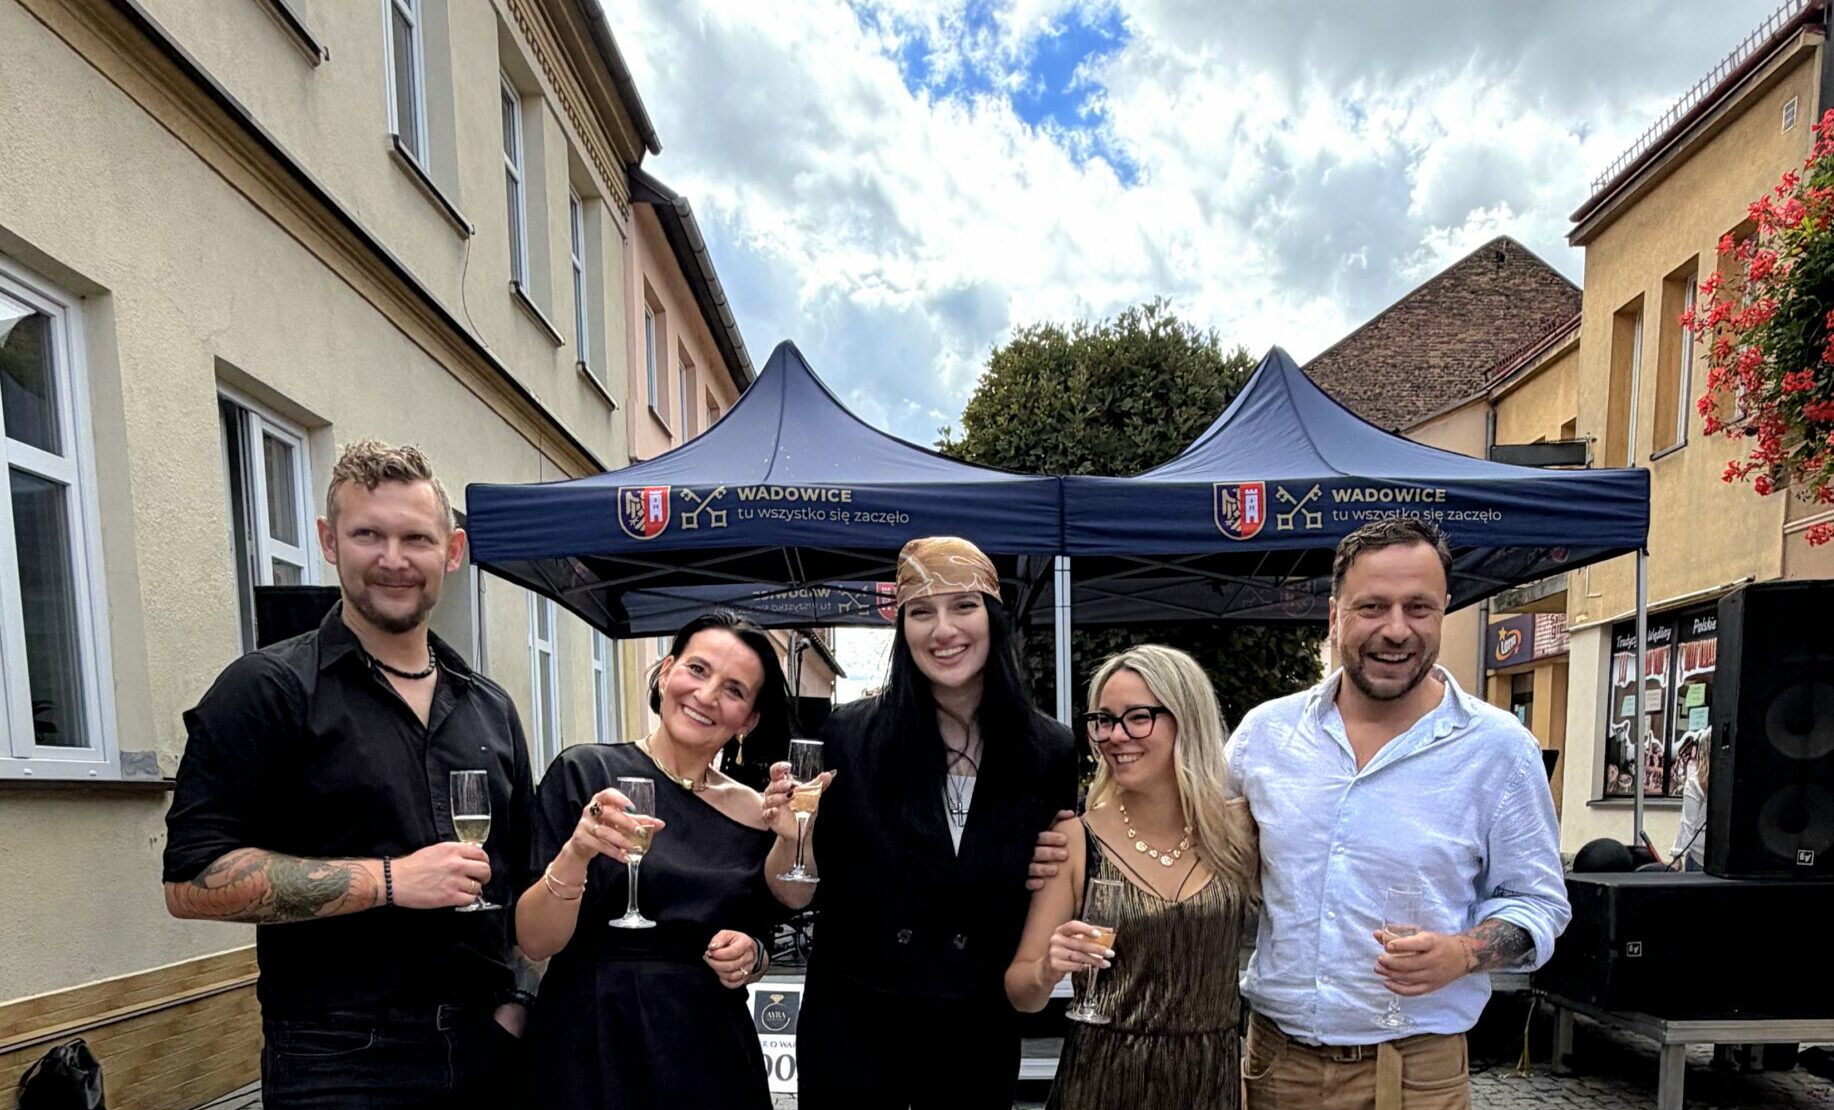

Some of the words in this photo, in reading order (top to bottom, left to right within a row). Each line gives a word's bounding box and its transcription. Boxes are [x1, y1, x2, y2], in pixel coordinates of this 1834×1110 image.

[737, 486, 852, 503] WADOWICE
[1332, 488, 1447, 503] WADOWICE
[738, 508, 753, 519] tu
[758, 507, 826, 522] wszystko
[829, 508, 850, 525] się
[854, 510, 910, 526] zaczęło
[1333, 509, 1348, 521] tu
[1352, 507, 1420, 521] wszystko
[1423, 508, 1444, 524] się
[1447, 508, 1502, 524] zaczęło
[1692, 616, 1717, 636] Polskie
